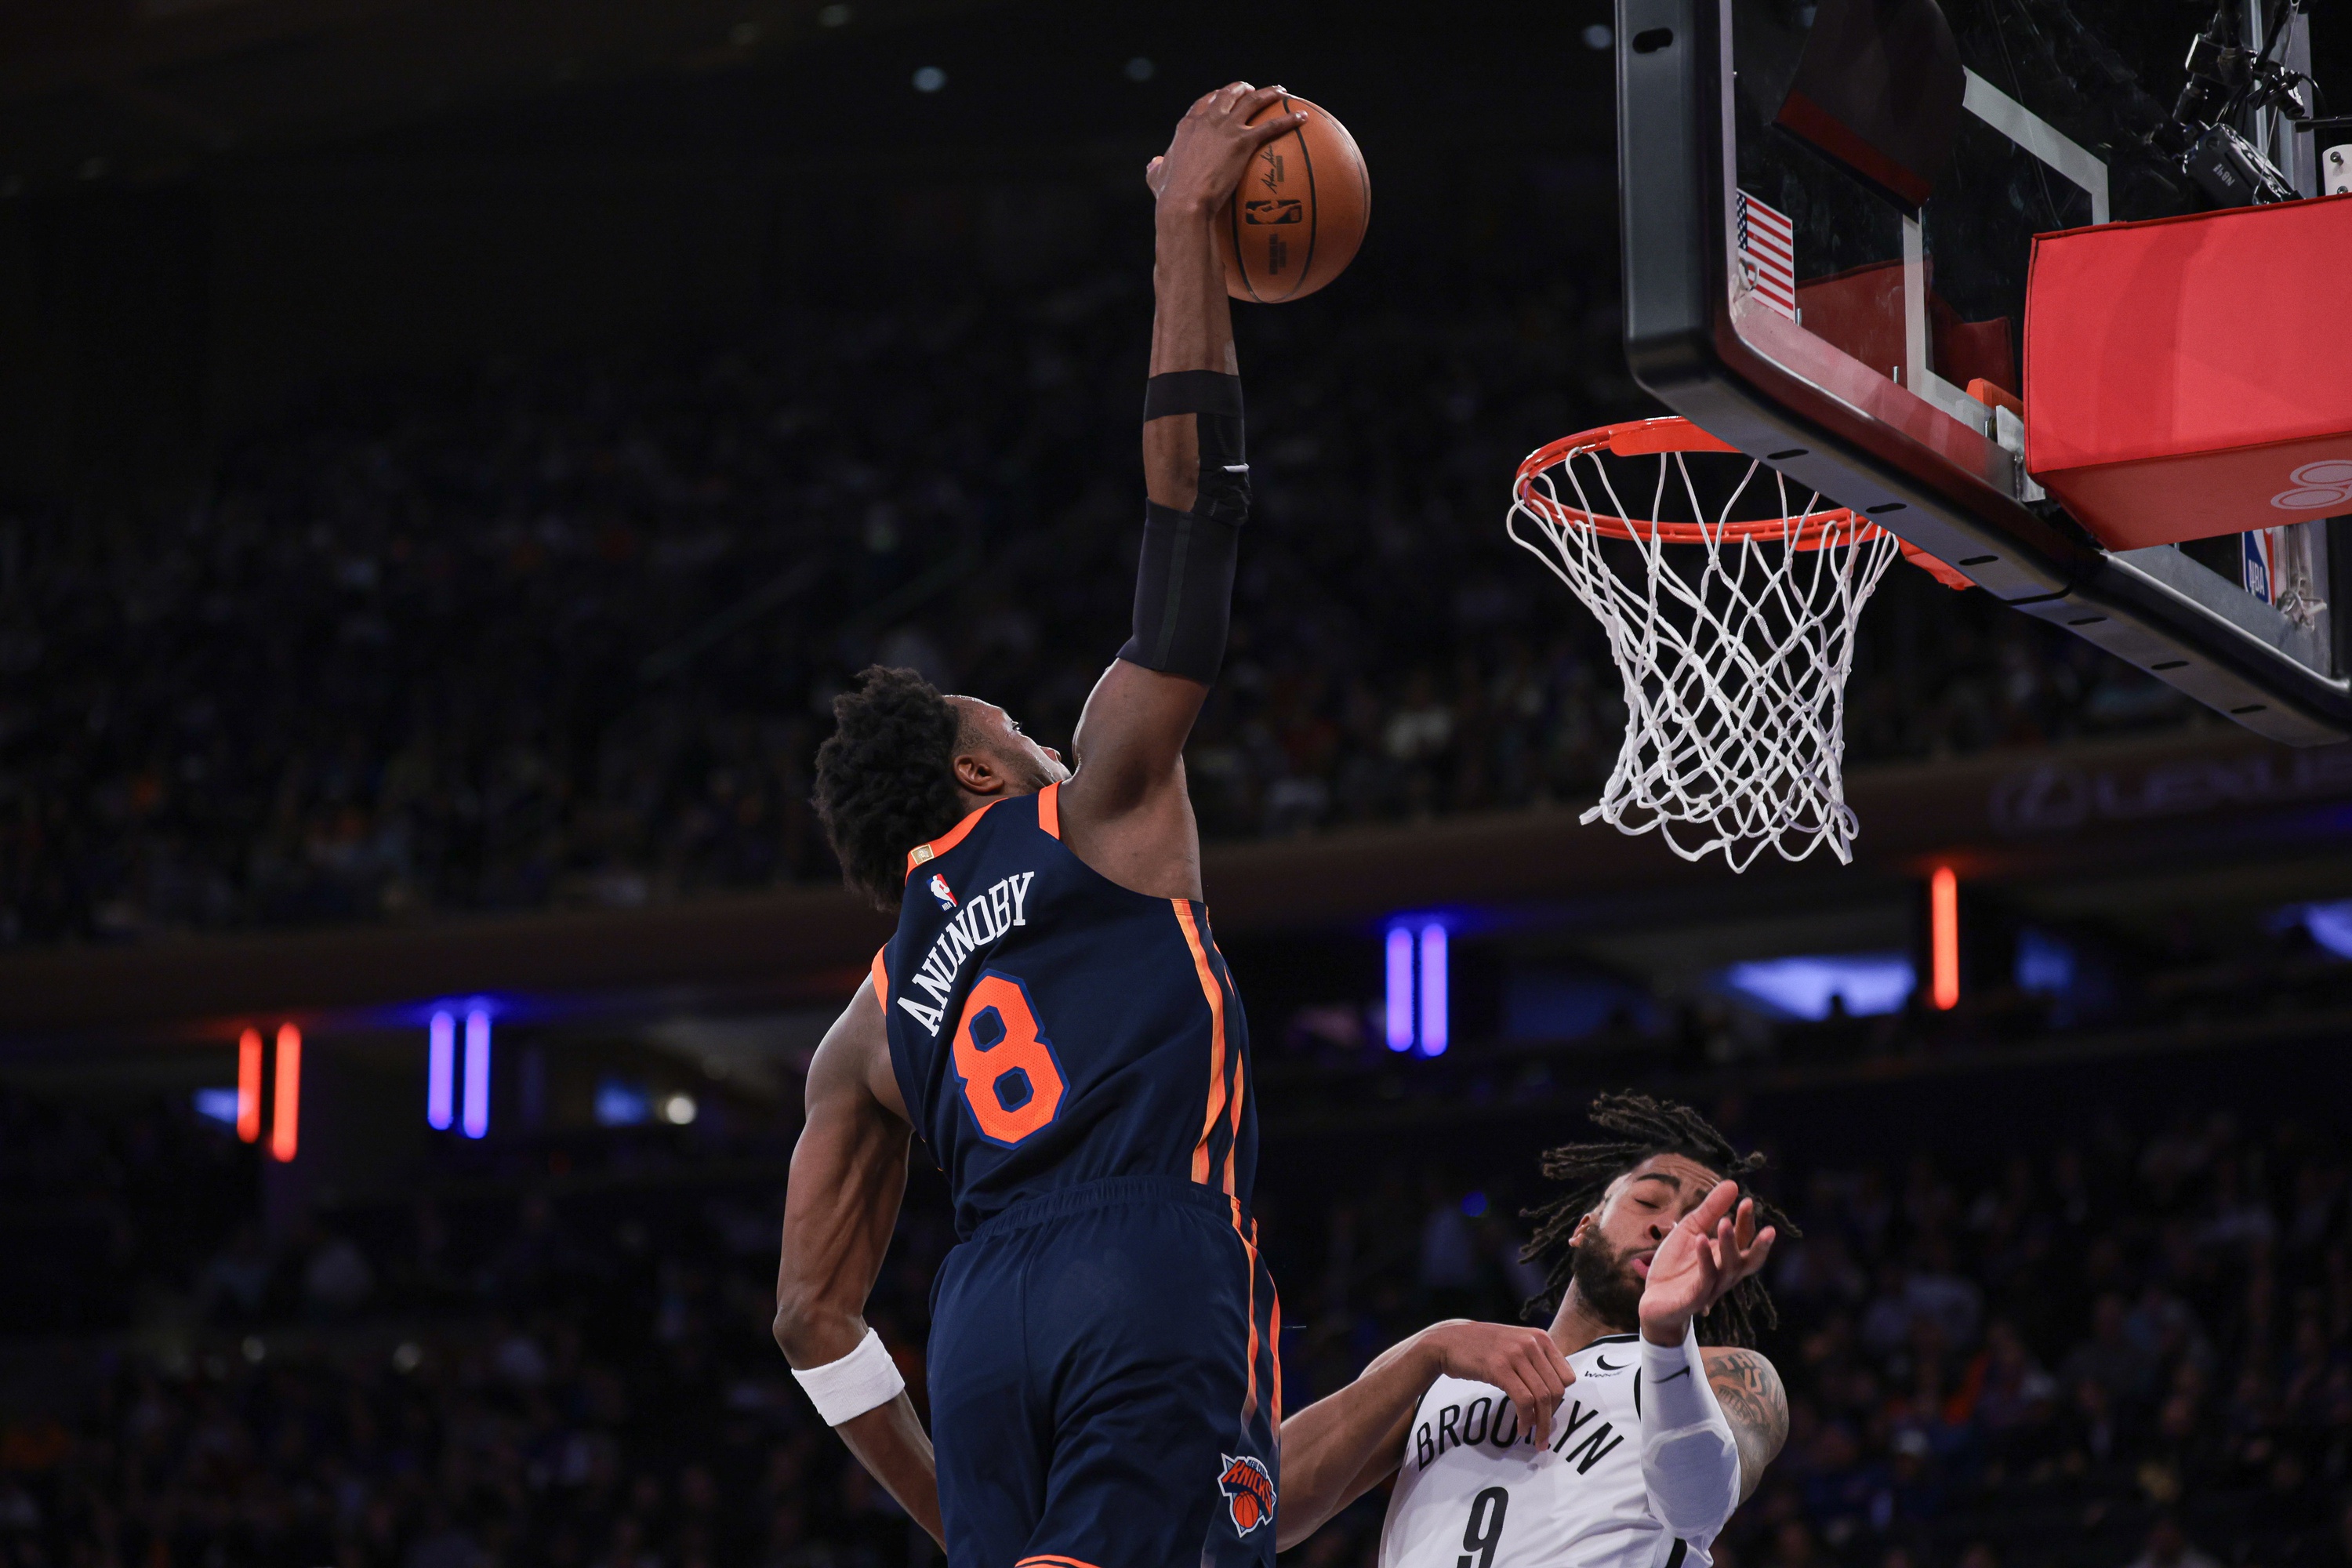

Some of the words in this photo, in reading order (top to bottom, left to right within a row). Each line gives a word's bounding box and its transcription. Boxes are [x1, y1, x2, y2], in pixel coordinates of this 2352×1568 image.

[2248, 559, 2266, 597] NBA
[942, 901, 953, 911] NBA
[897, 871, 1034, 1037] ANUNOBY
[952, 969, 1070, 1150] 8
[1416, 1396, 1624, 1475] BROOYN
[1221, 1460, 1272, 1516] KNICKS
[1457, 1486, 1509, 1568] 9
